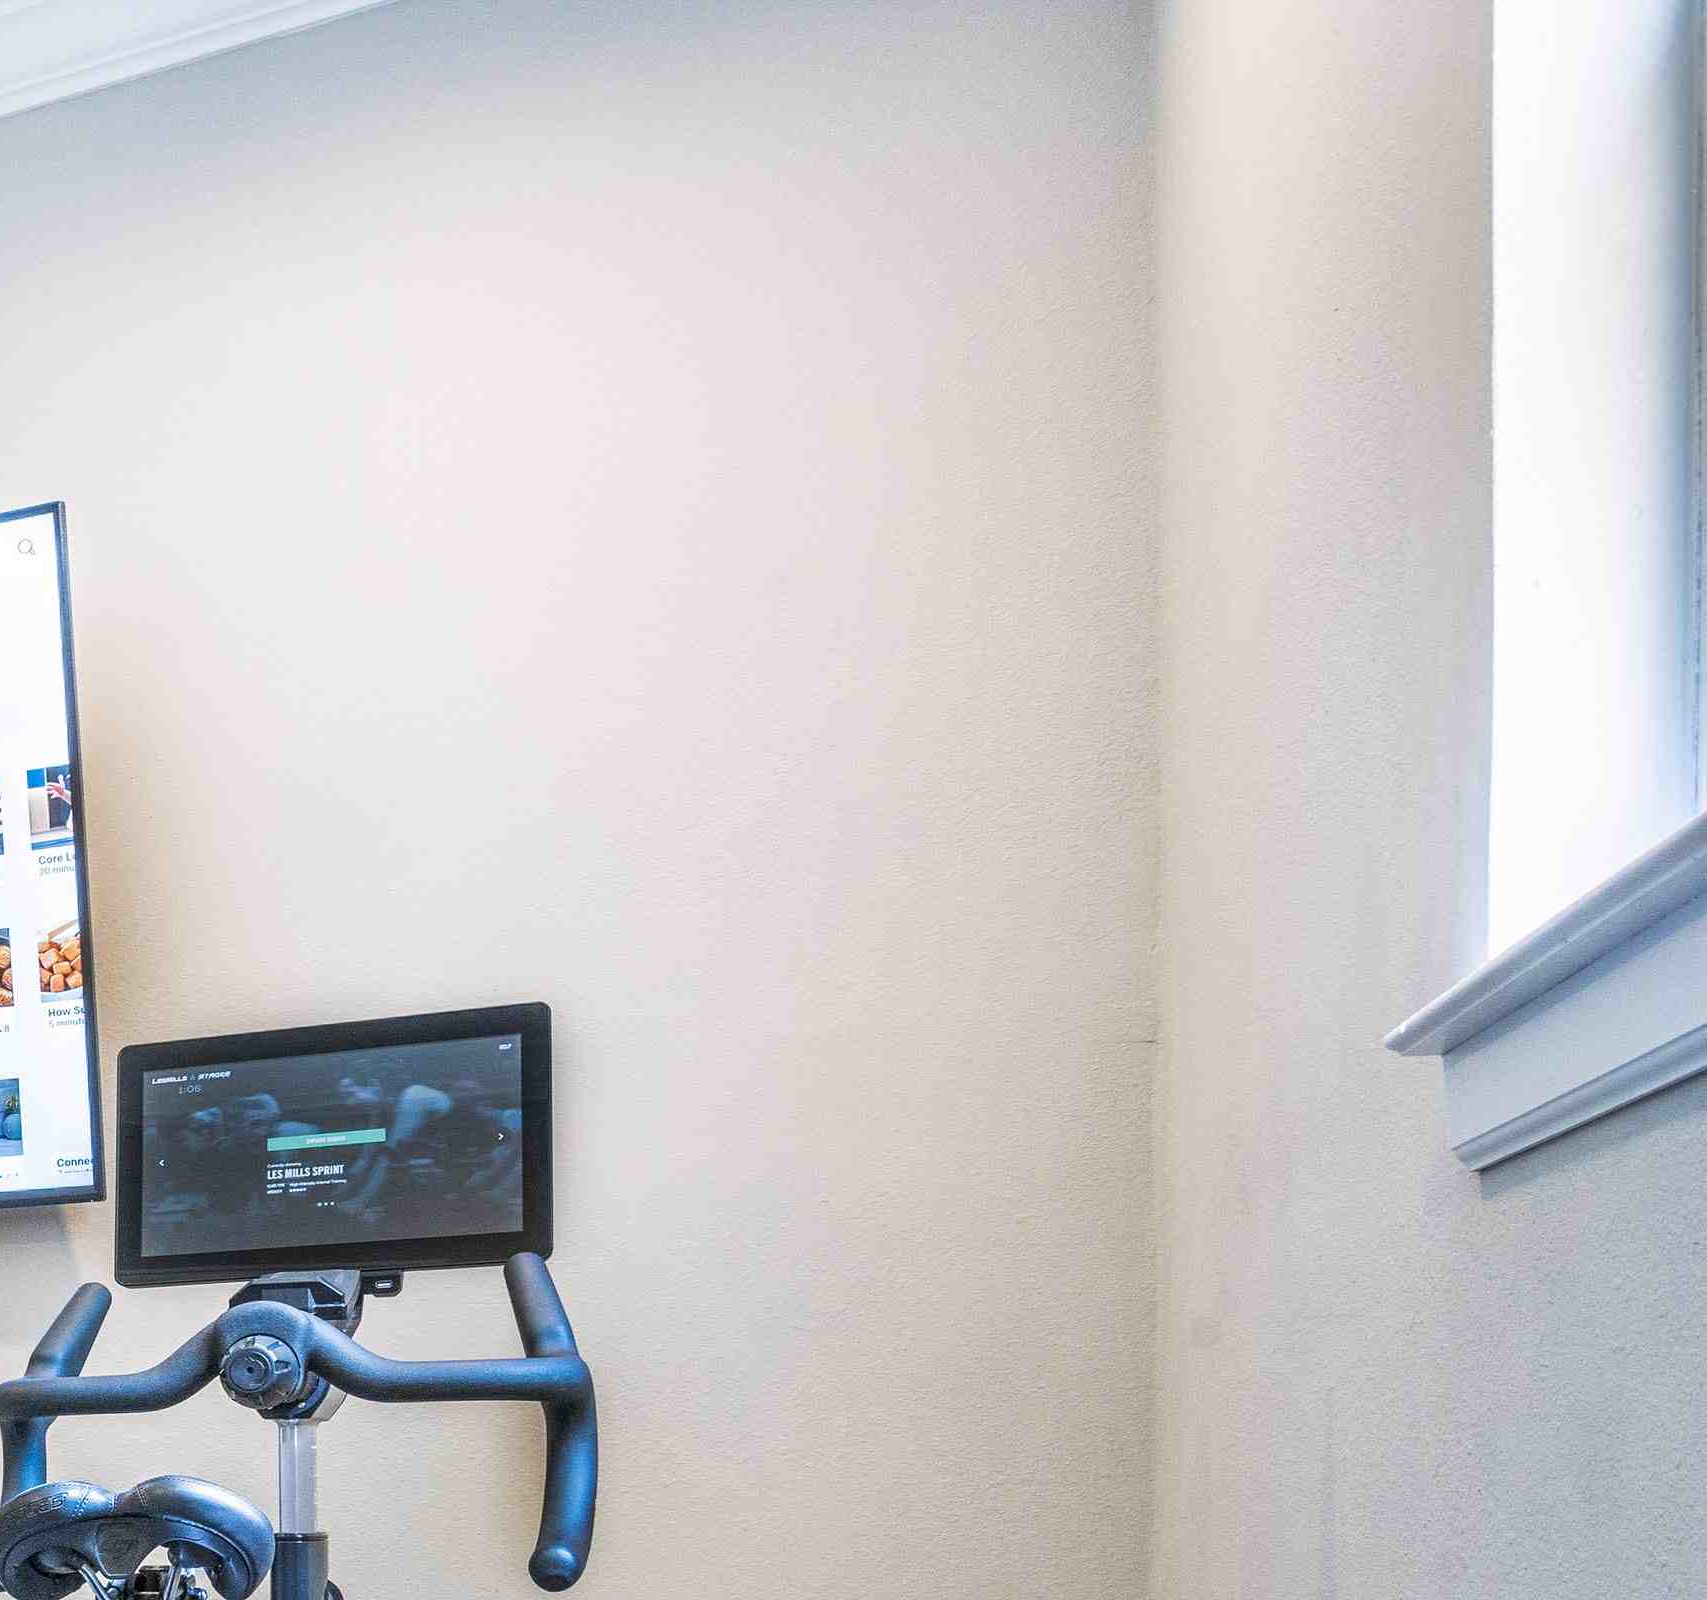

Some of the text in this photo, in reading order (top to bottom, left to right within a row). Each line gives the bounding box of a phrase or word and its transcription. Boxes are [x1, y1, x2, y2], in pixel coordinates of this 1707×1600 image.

[38, 854, 62, 865] Core
[47, 1007, 71, 1018] How
[267, 1168, 284, 1180] LES
[284, 1166, 311, 1179] MILLS
[312, 1164, 345, 1177] SPRINT
